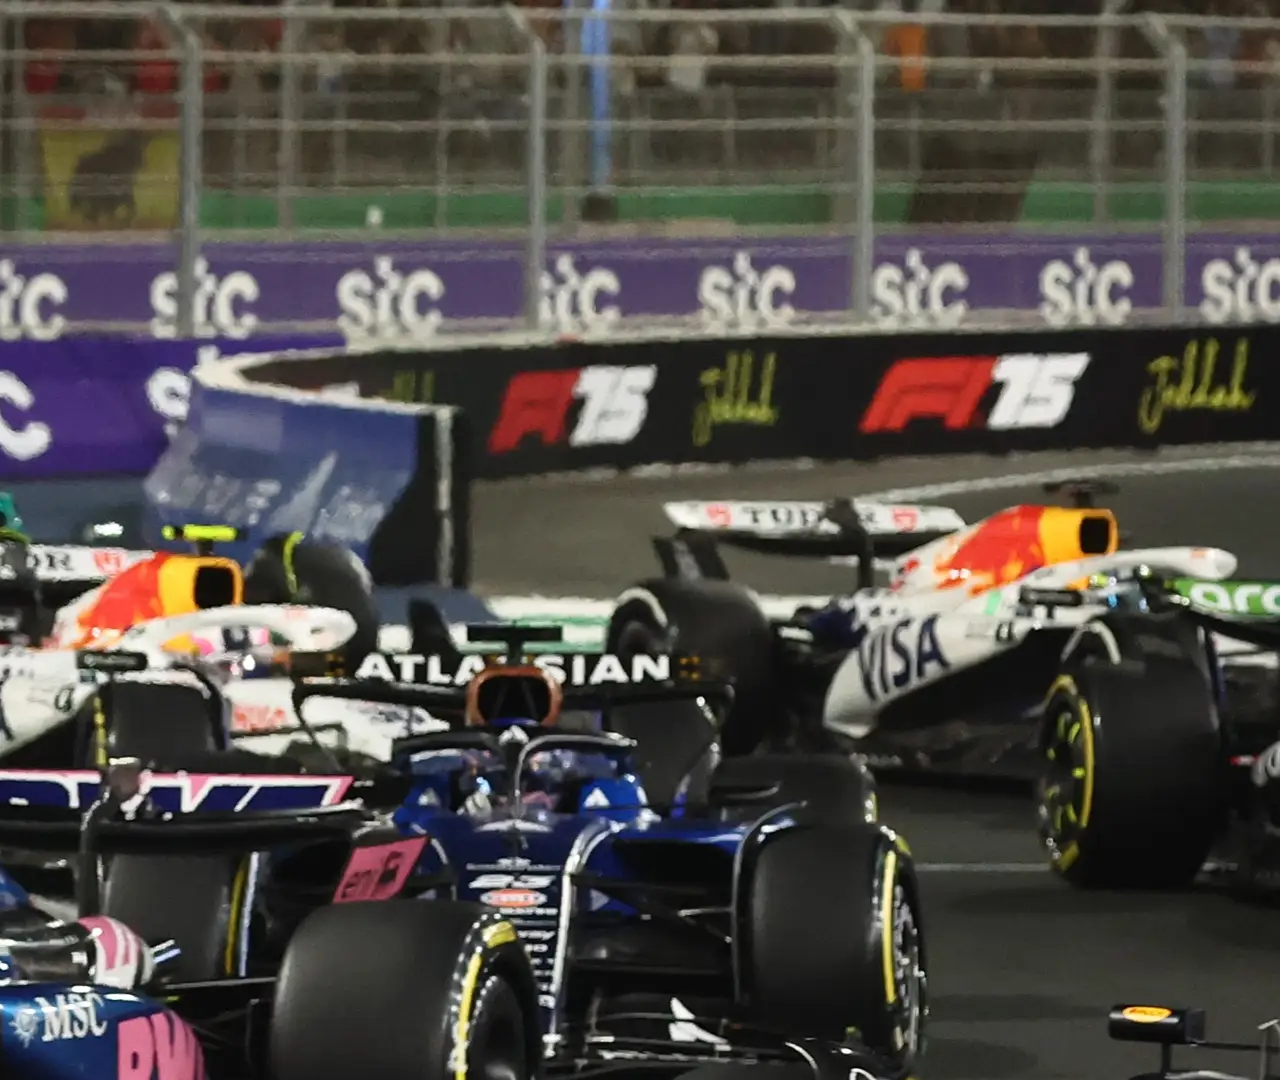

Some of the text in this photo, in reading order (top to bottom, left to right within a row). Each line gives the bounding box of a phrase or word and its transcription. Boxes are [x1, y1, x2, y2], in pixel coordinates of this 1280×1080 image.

[150, 256, 259, 339] stc
[336, 254, 444, 336] stc
[697, 250, 796, 327] stc
[871, 248, 968, 325] stc
[1039, 246, 1133, 324] stc
[356, 652, 671, 686] ATLASIAN
[858, 613, 953, 702] VISA
[39, 991, 109, 1043] MSC
